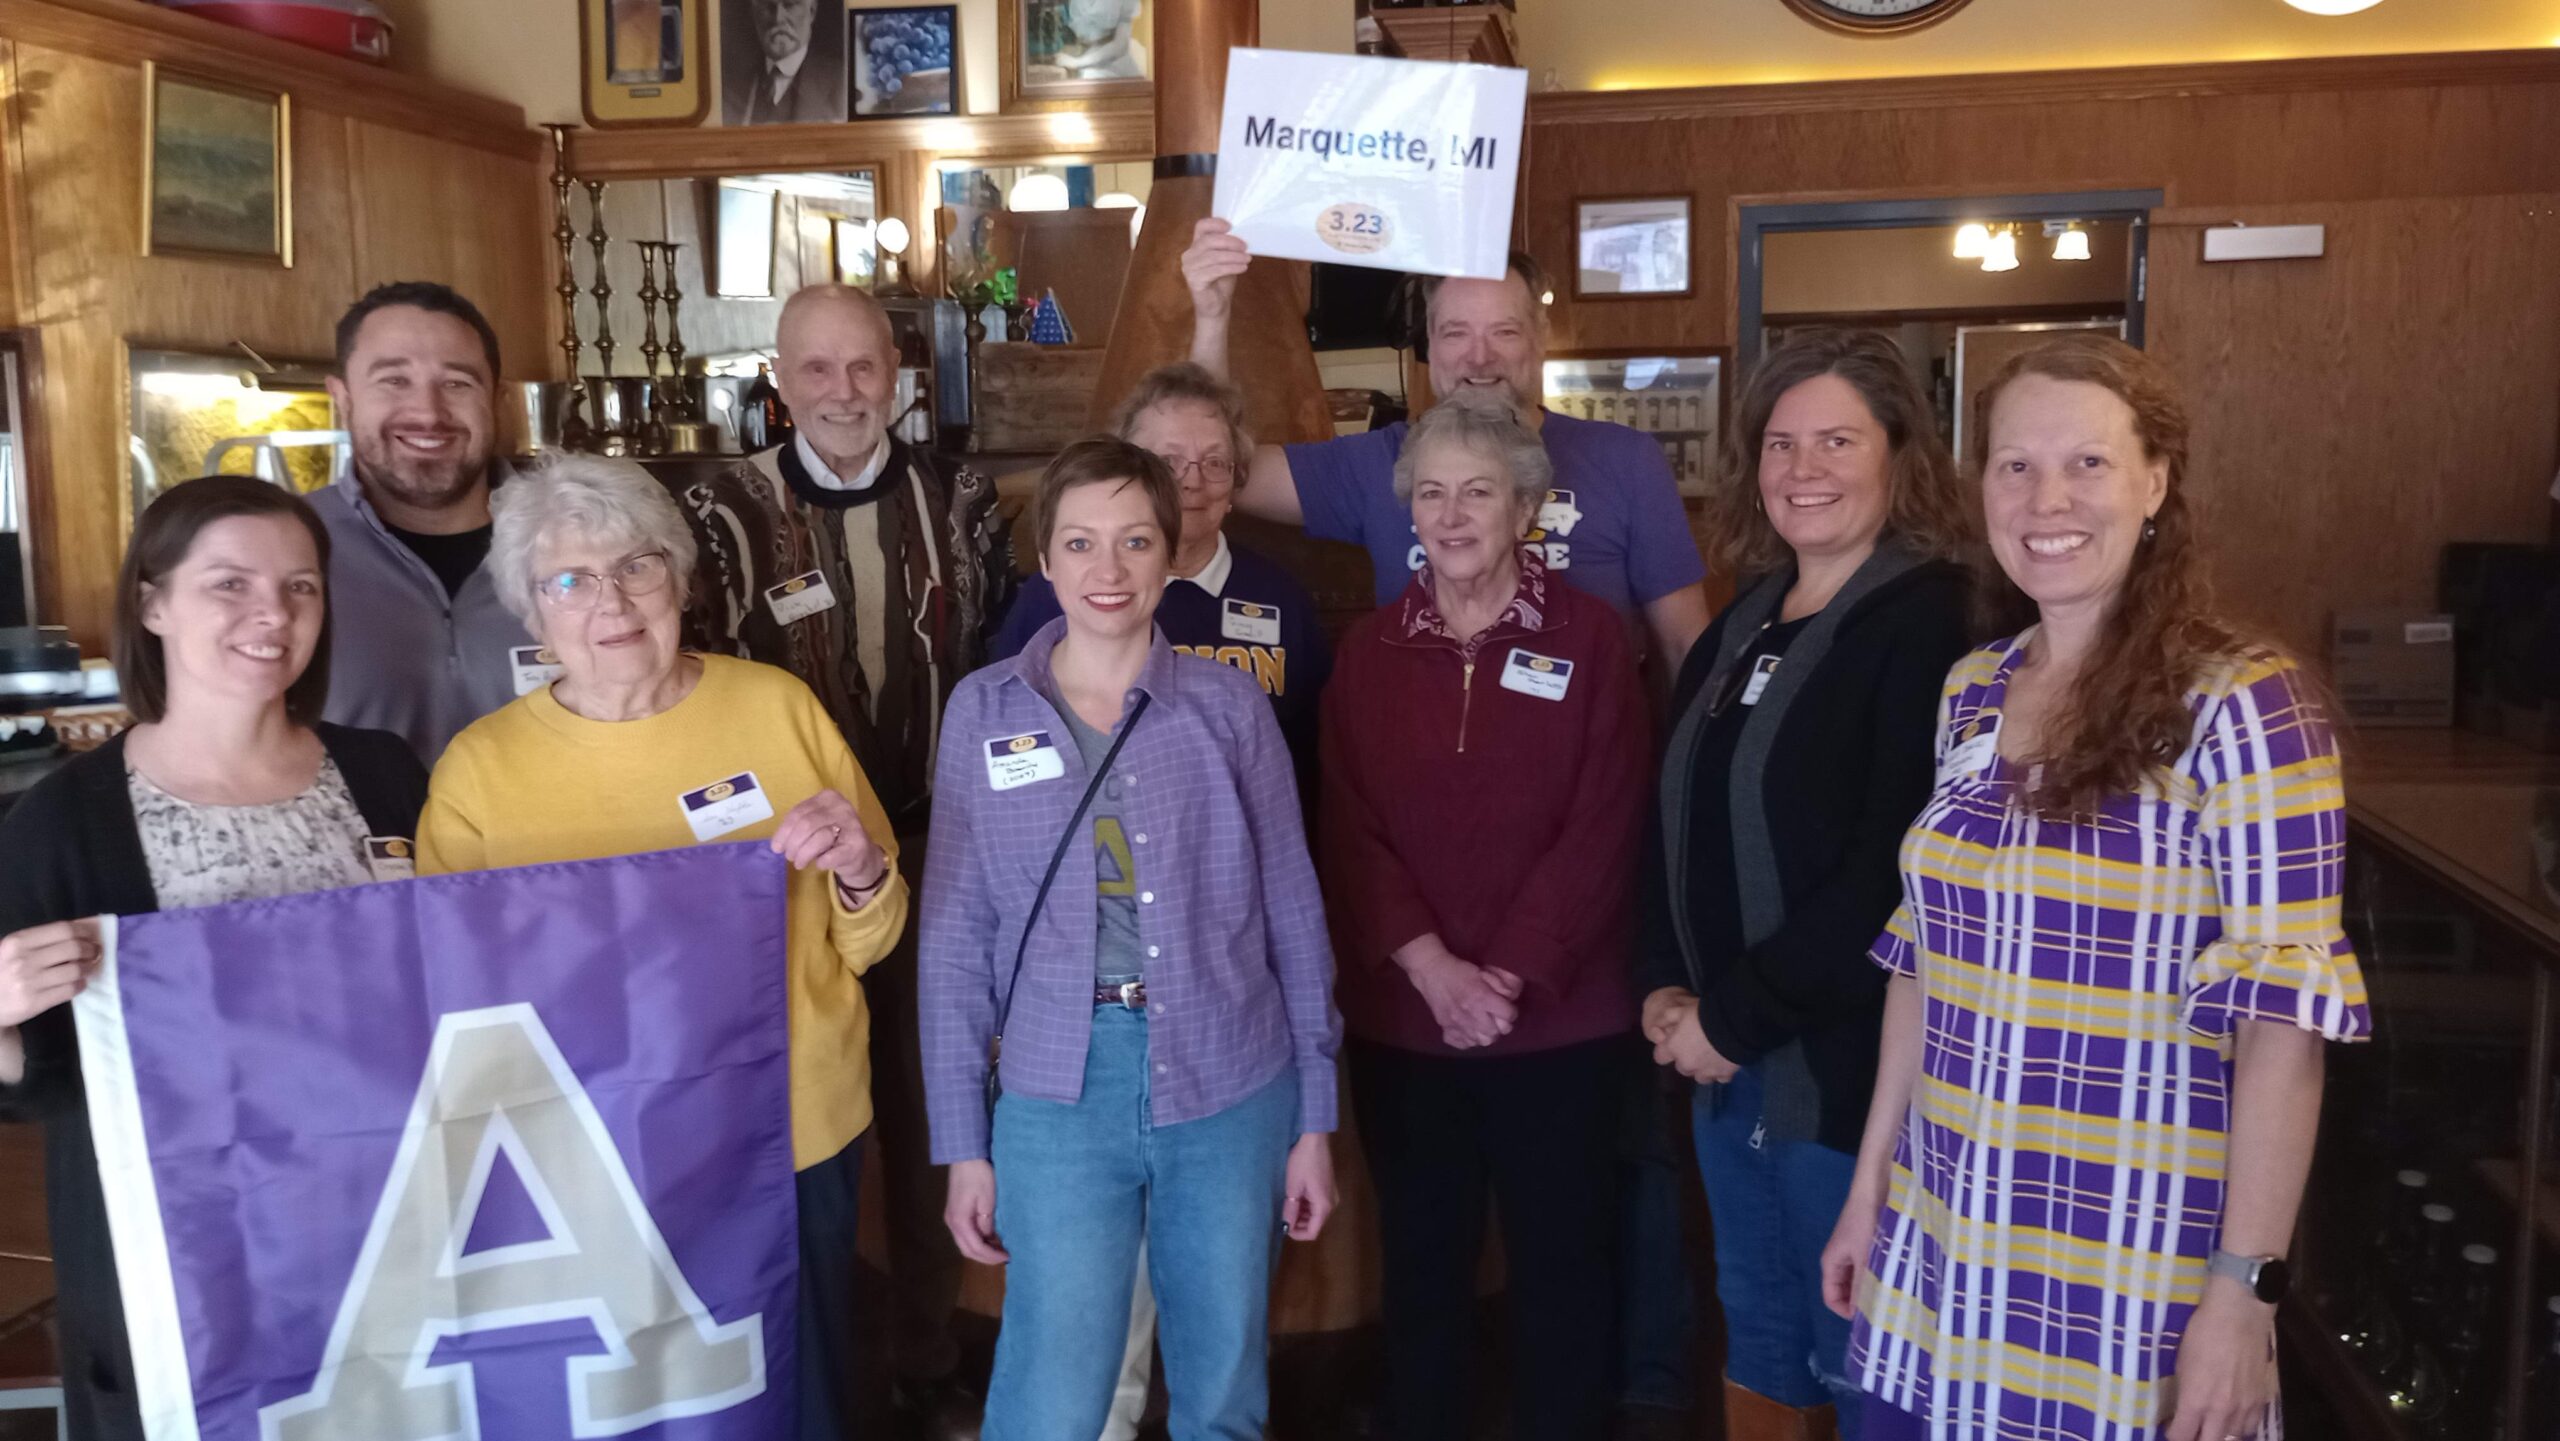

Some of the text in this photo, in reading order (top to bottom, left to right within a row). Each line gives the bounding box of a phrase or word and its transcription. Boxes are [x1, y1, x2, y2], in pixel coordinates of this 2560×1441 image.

[1244, 115, 1497, 171] Marquette, MI
[1329, 210, 1383, 235] 3.23
[258, 1001, 767, 1441] A
